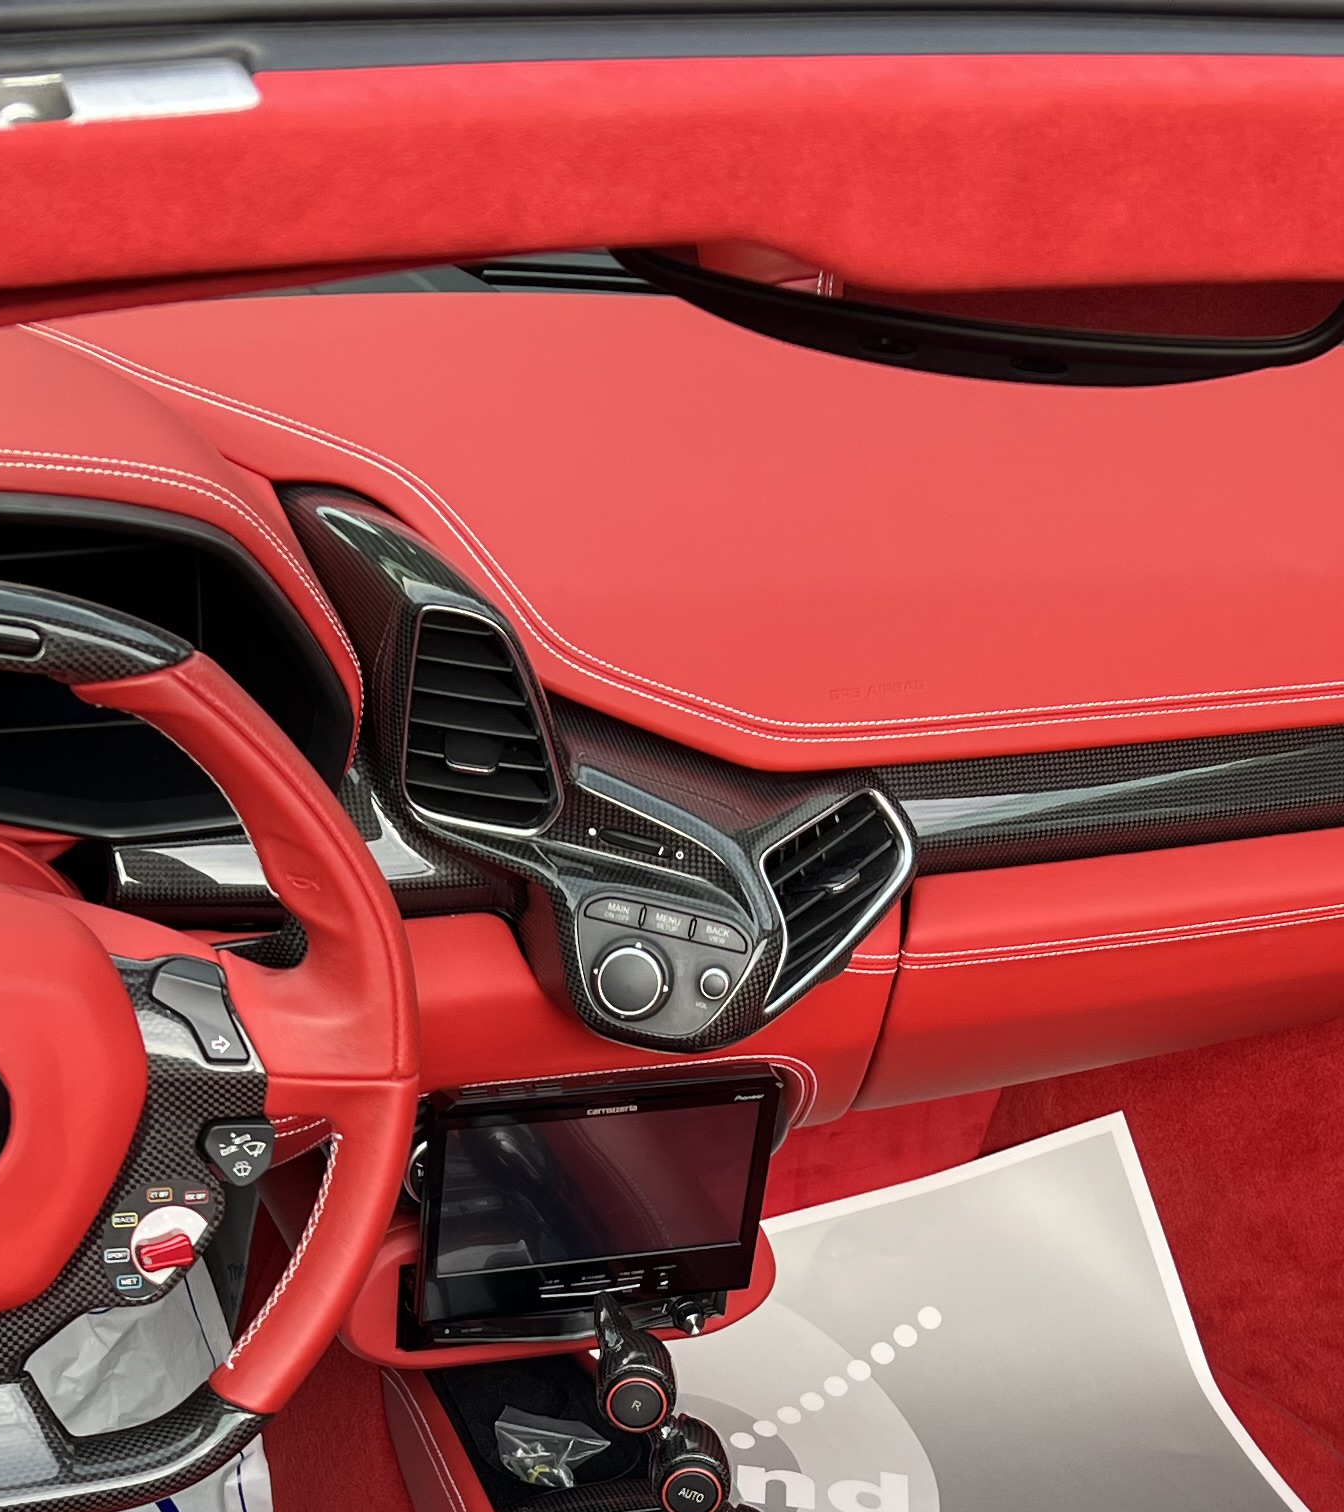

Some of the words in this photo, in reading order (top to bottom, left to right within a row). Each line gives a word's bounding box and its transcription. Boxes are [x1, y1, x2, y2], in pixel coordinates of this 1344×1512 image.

[607, 902, 631, 914] MAIN
[655, 912, 682, 927] MENU
[706, 924, 730, 938] BACK
[708, 934, 726, 945] VIEW
[695, 1001, 707, 1010] VOL
[120, 1277, 138, 1286] WET
[631, 1400, 642, 1412] R
[678, 1486, 705, 1503] AUTO
